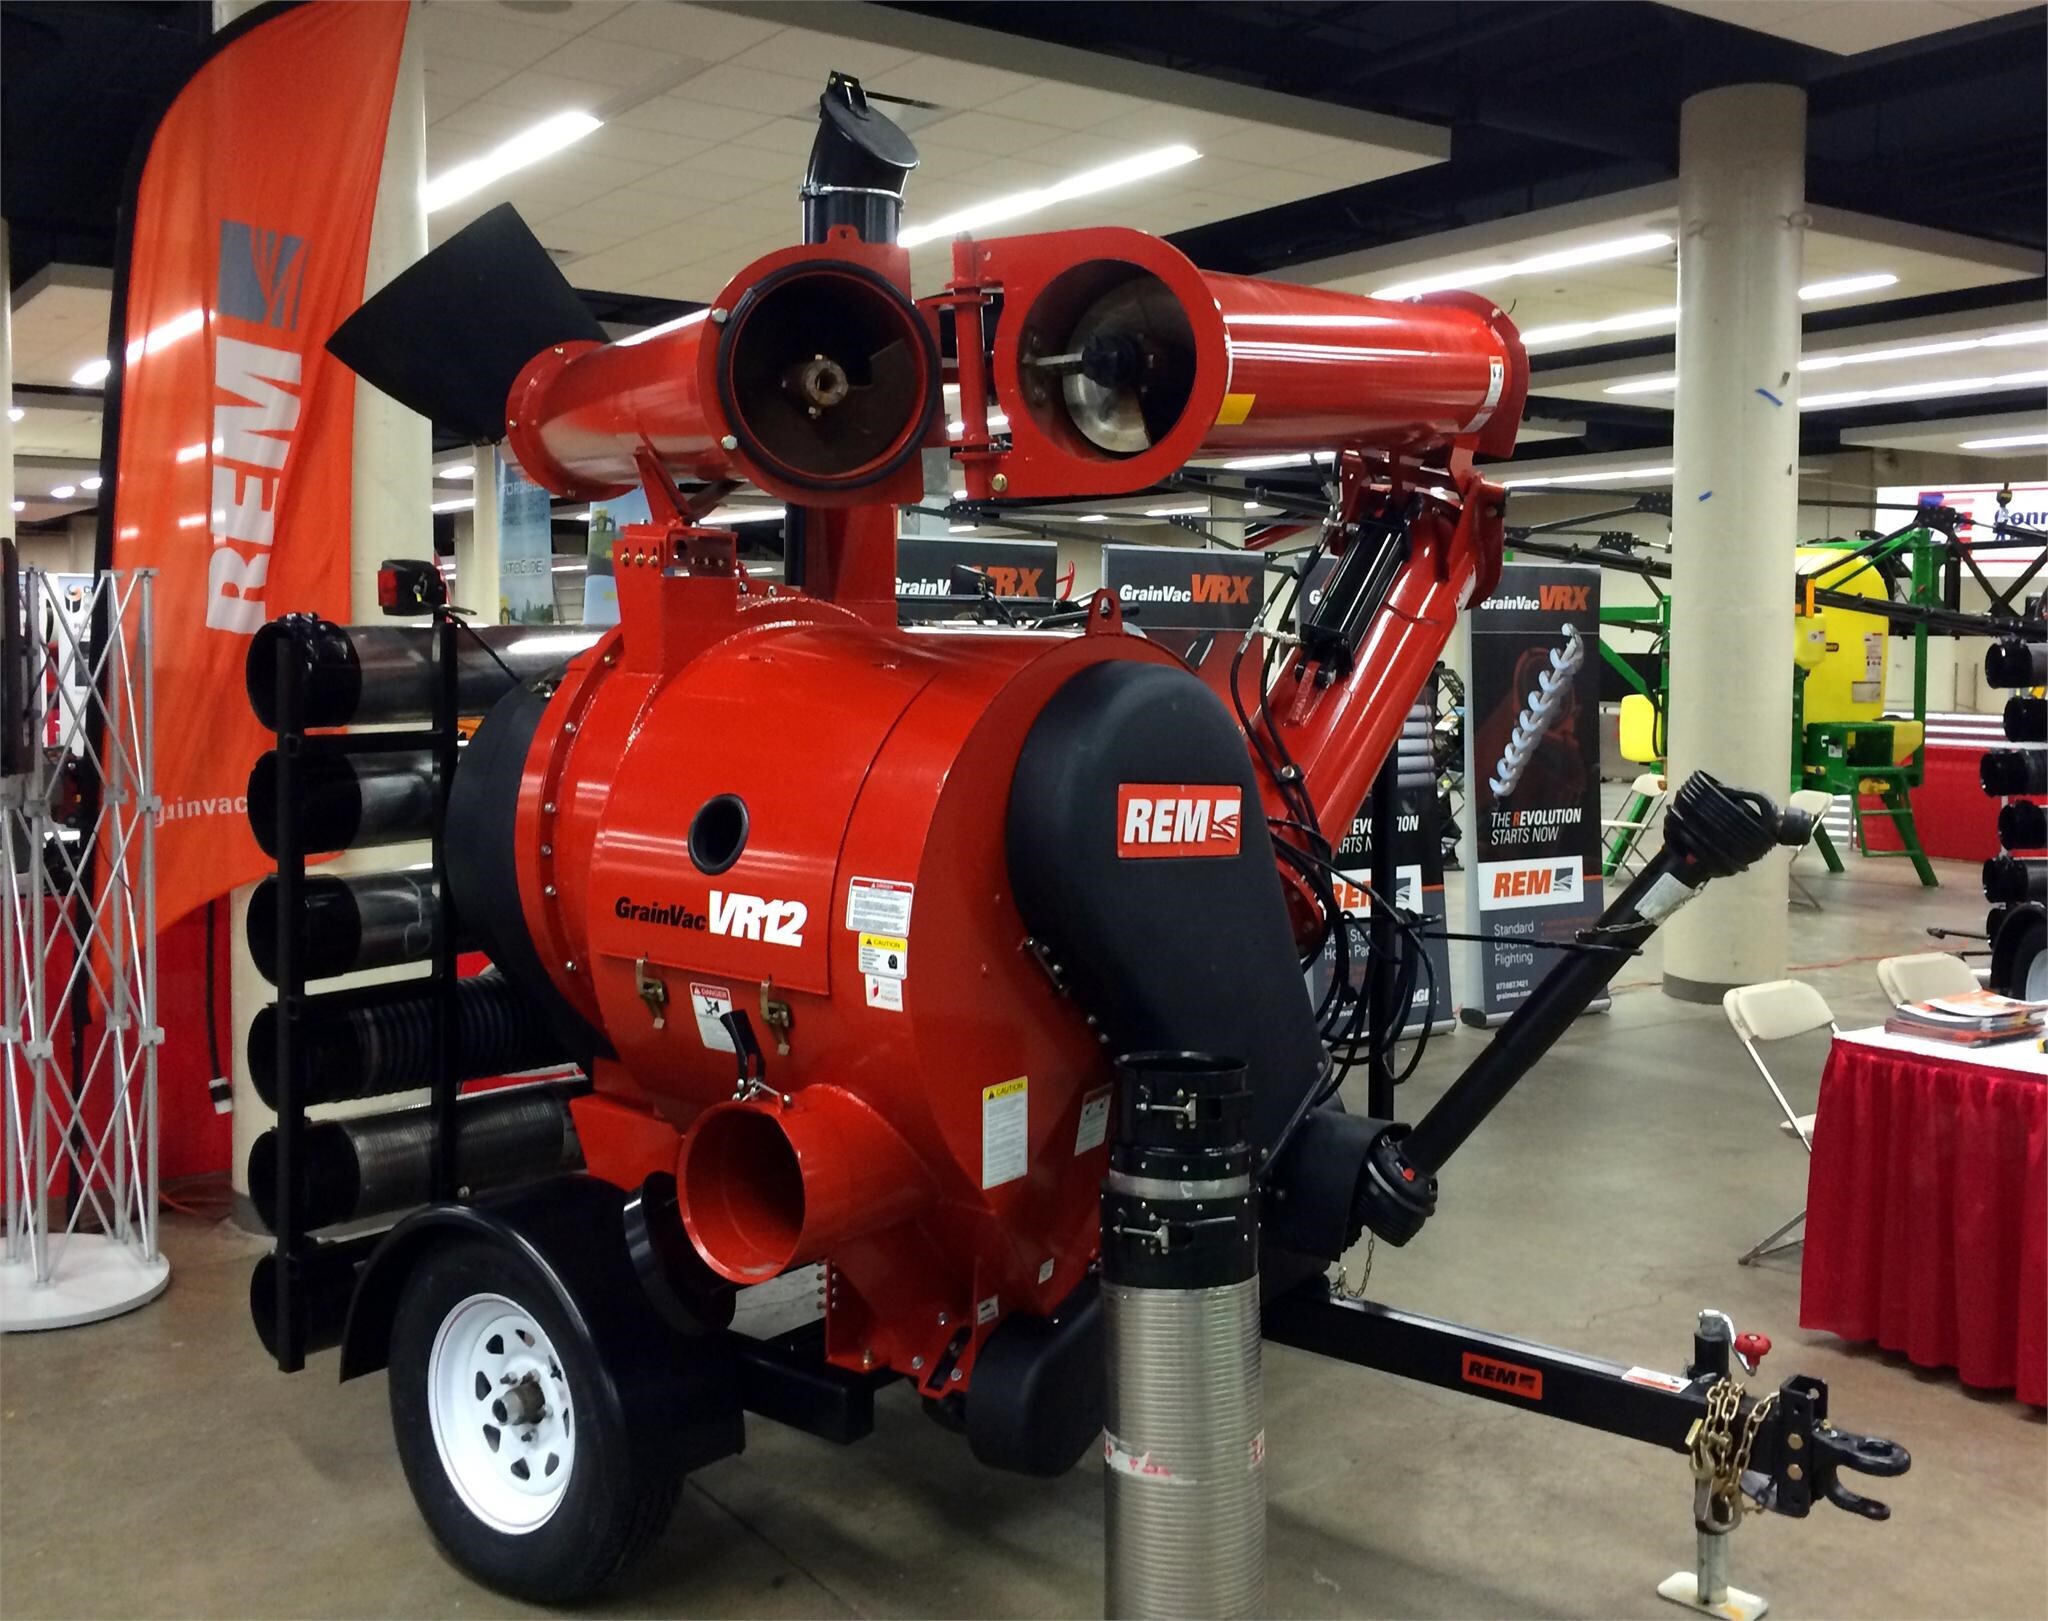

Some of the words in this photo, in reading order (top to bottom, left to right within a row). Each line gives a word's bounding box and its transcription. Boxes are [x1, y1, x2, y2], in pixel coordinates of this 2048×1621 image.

[206, 336, 302, 634] REM
[1119, 584, 1191, 603] GrainVac
[1191, 573, 1254, 605] VRX
[1539, 585, 1591, 611] VRX
[1123, 798, 1211, 843] REM
[1491, 812, 1512, 828] THE
[1512, 808, 1582, 827] REVOLUTION
[1491, 829, 1530, 846] STARTS
[1532, 826, 1559, 843] NOW
[1493, 869, 1552, 899] REM
[615, 896, 708, 931] GrainVac
[708, 889, 808, 947] VR12
[1494, 921, 1535, 937] Standard
[1495, 952, 1534, 968] Flighting
[1468, 1360, 1518, 1386] REM
